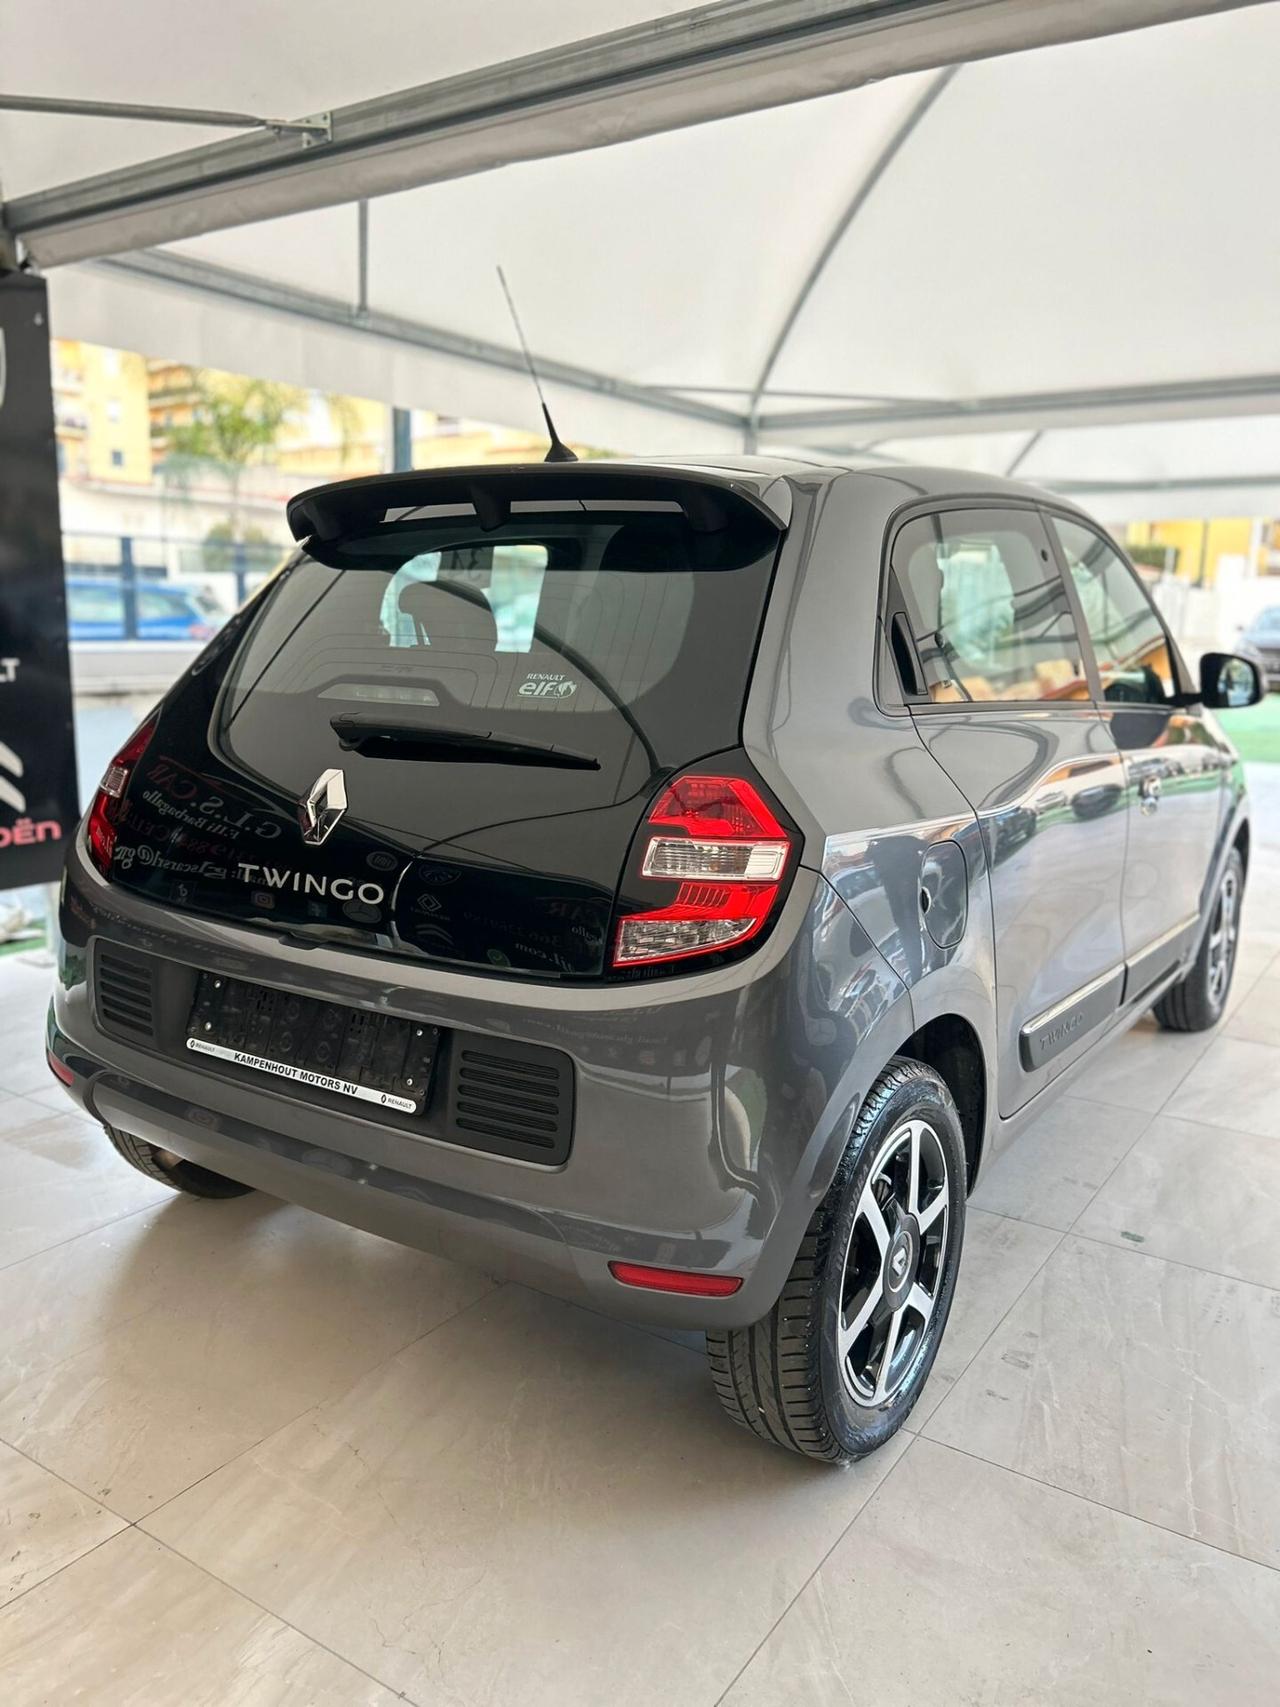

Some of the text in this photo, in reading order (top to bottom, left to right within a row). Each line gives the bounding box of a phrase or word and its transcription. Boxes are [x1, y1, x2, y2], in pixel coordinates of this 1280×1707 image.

[526, 673, 566, 681] RENAULT
[518, 681, 558, 696] elf
[238, 862, 384, 905] TWINGO
[234, 1053, 358, 1095] KAMPENHOUT MOTORS NV
[387, 1098, 412, 1109] RENAULT
